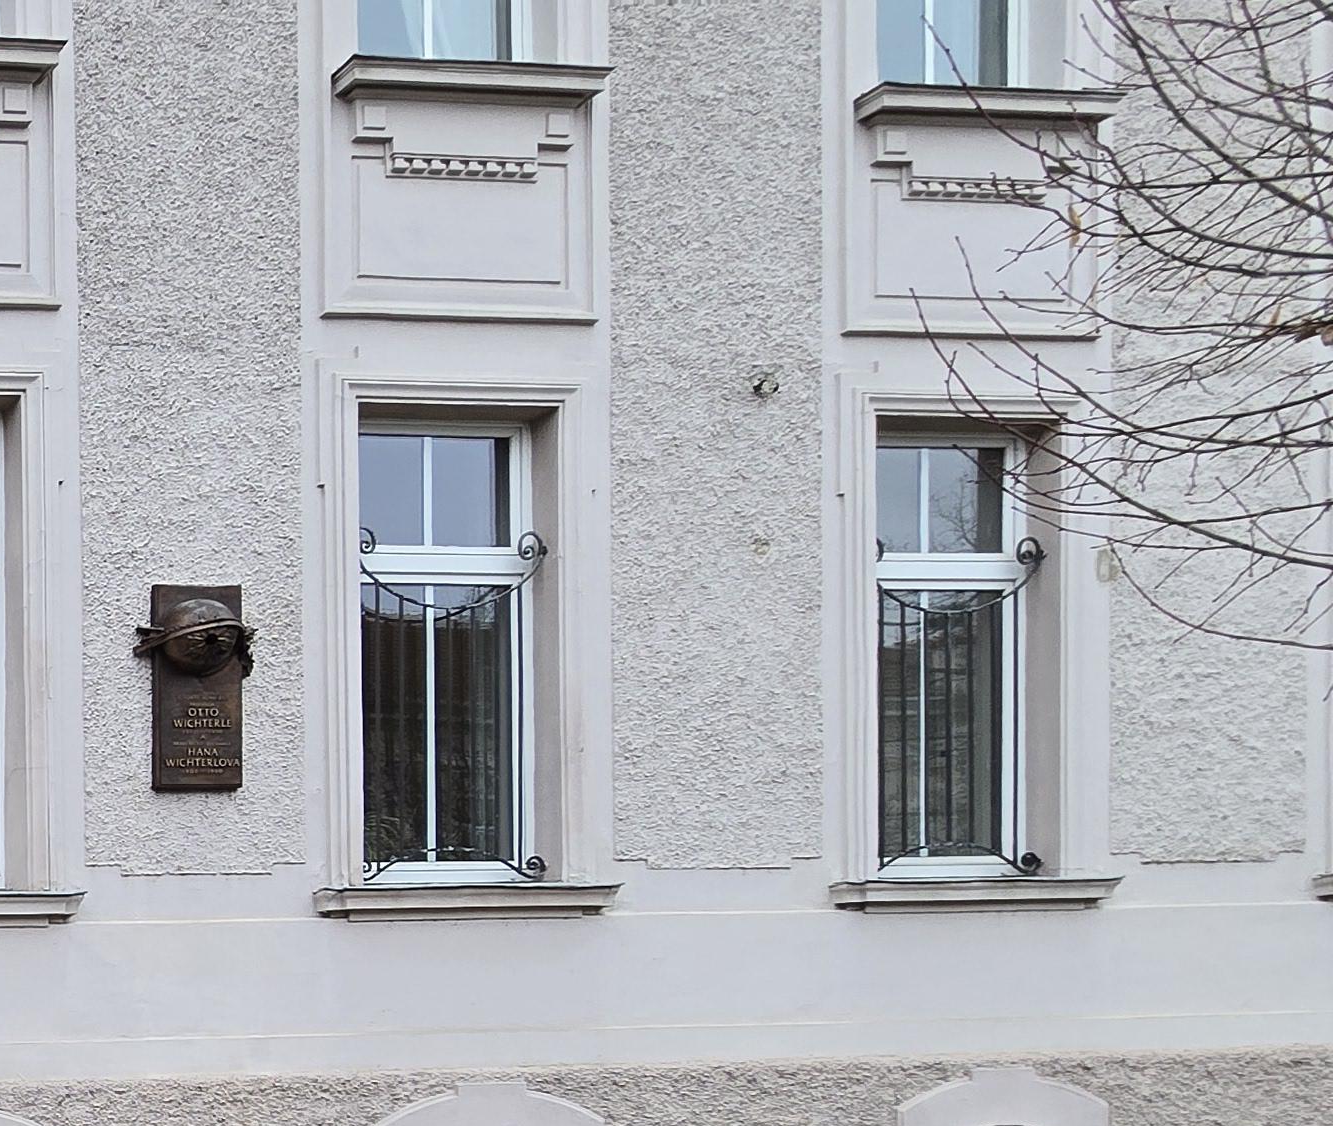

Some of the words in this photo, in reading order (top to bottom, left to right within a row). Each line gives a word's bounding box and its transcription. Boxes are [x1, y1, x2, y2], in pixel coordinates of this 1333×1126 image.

[188, 708, 219, 717] OTTO
[173, 719, 232, 728] WICHTERLE
[188, 747, 218, 756] HANA
